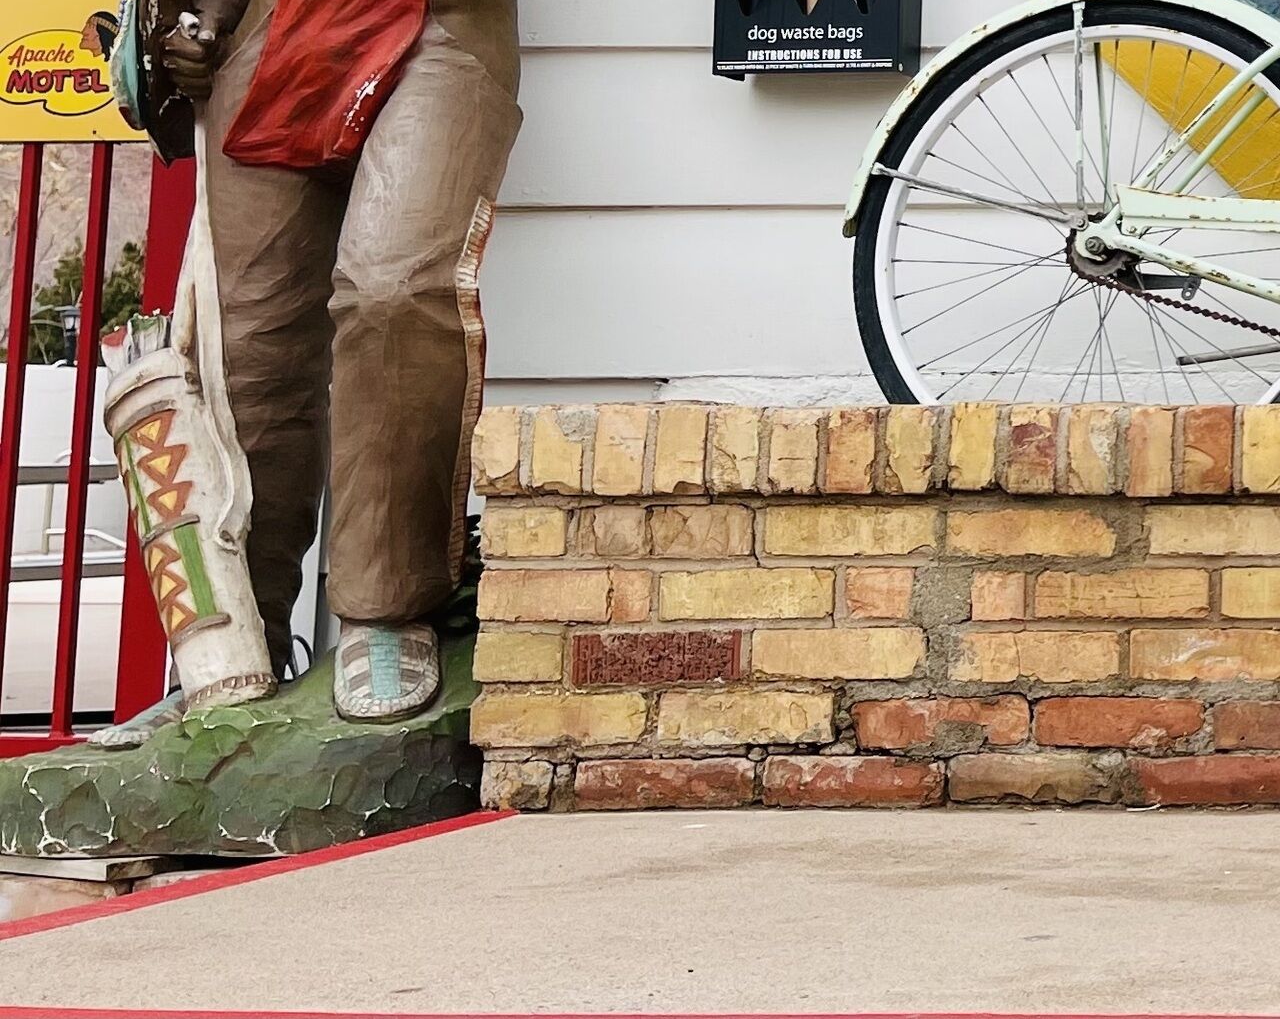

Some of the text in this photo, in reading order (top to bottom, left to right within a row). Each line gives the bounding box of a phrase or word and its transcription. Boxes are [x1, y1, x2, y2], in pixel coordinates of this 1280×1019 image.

[748, 24, 863, 43] dog waste bags
[8, 44, 75, 66] Apache
[747, 48, 863, 61] INSTRUCTIONS FOR USE
[5, 68, 110, 94] MOTEL
